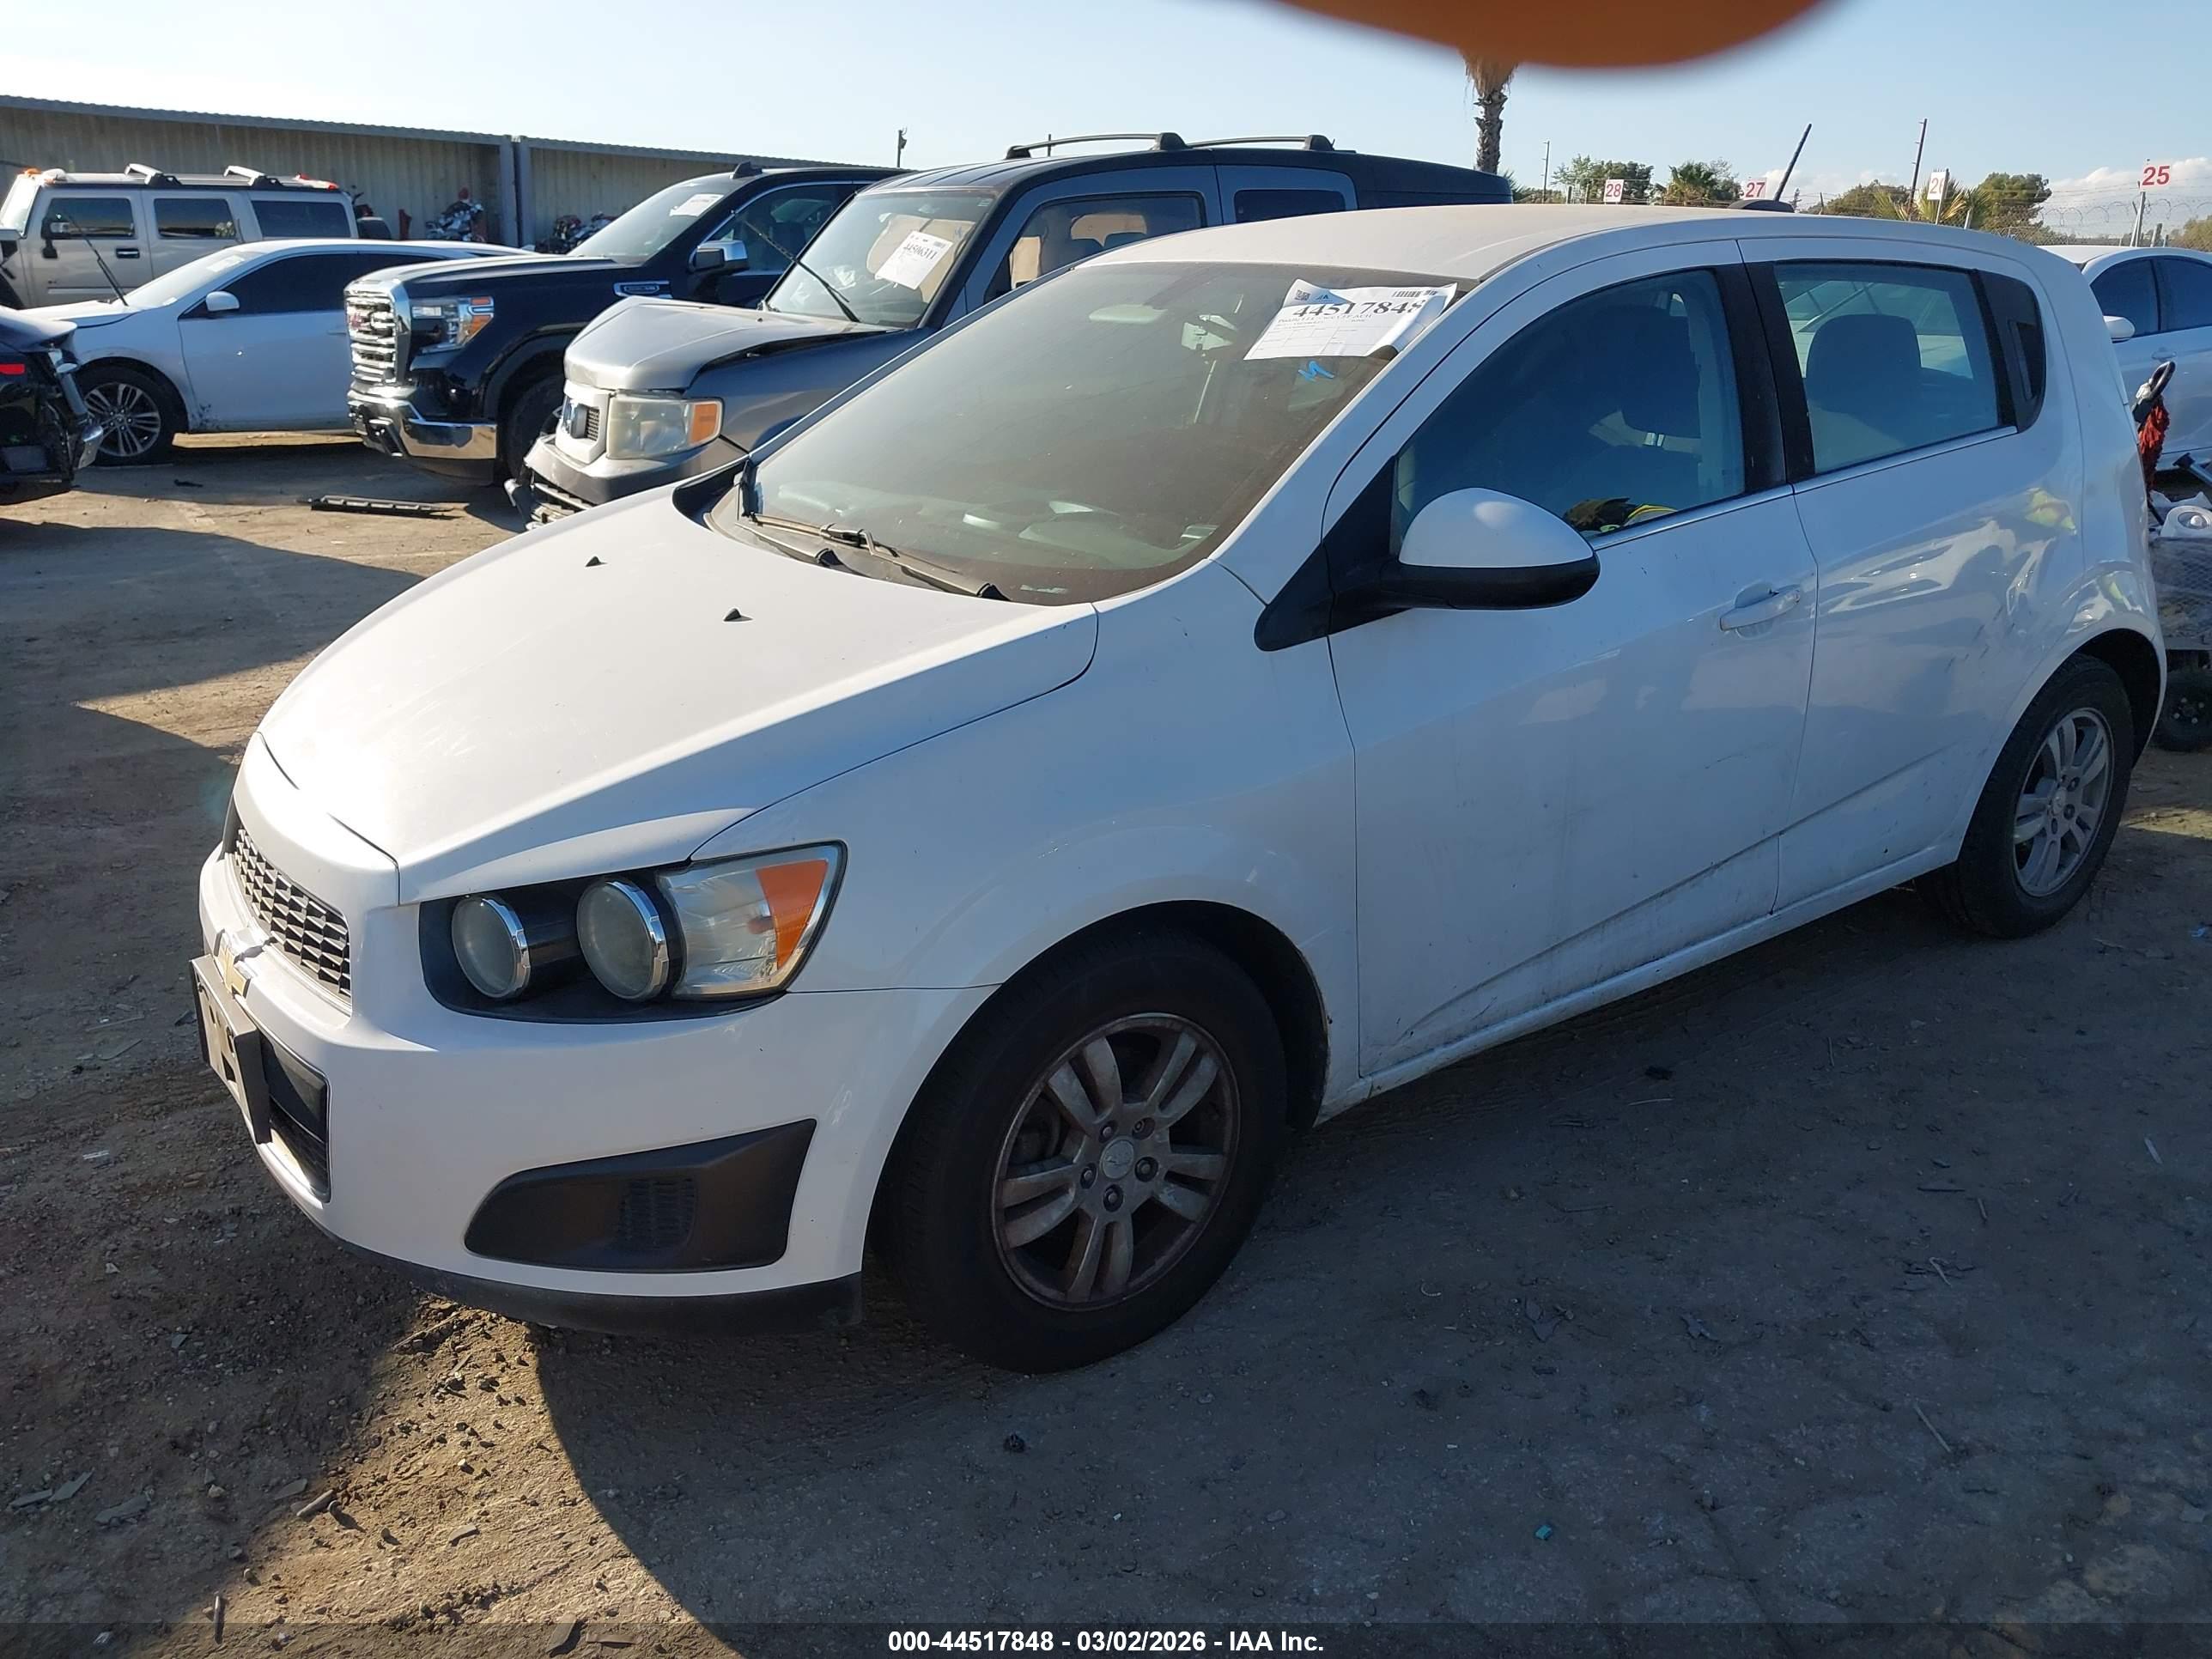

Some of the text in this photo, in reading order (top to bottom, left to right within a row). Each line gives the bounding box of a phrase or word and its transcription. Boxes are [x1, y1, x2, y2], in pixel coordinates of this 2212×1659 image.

[2142, 165, 2170, 185] 25
[1607, 184, 1621, 198] 28
[1746, 181, 1765, 198] 27
[1292, 299, 1426, 318] 44517848
